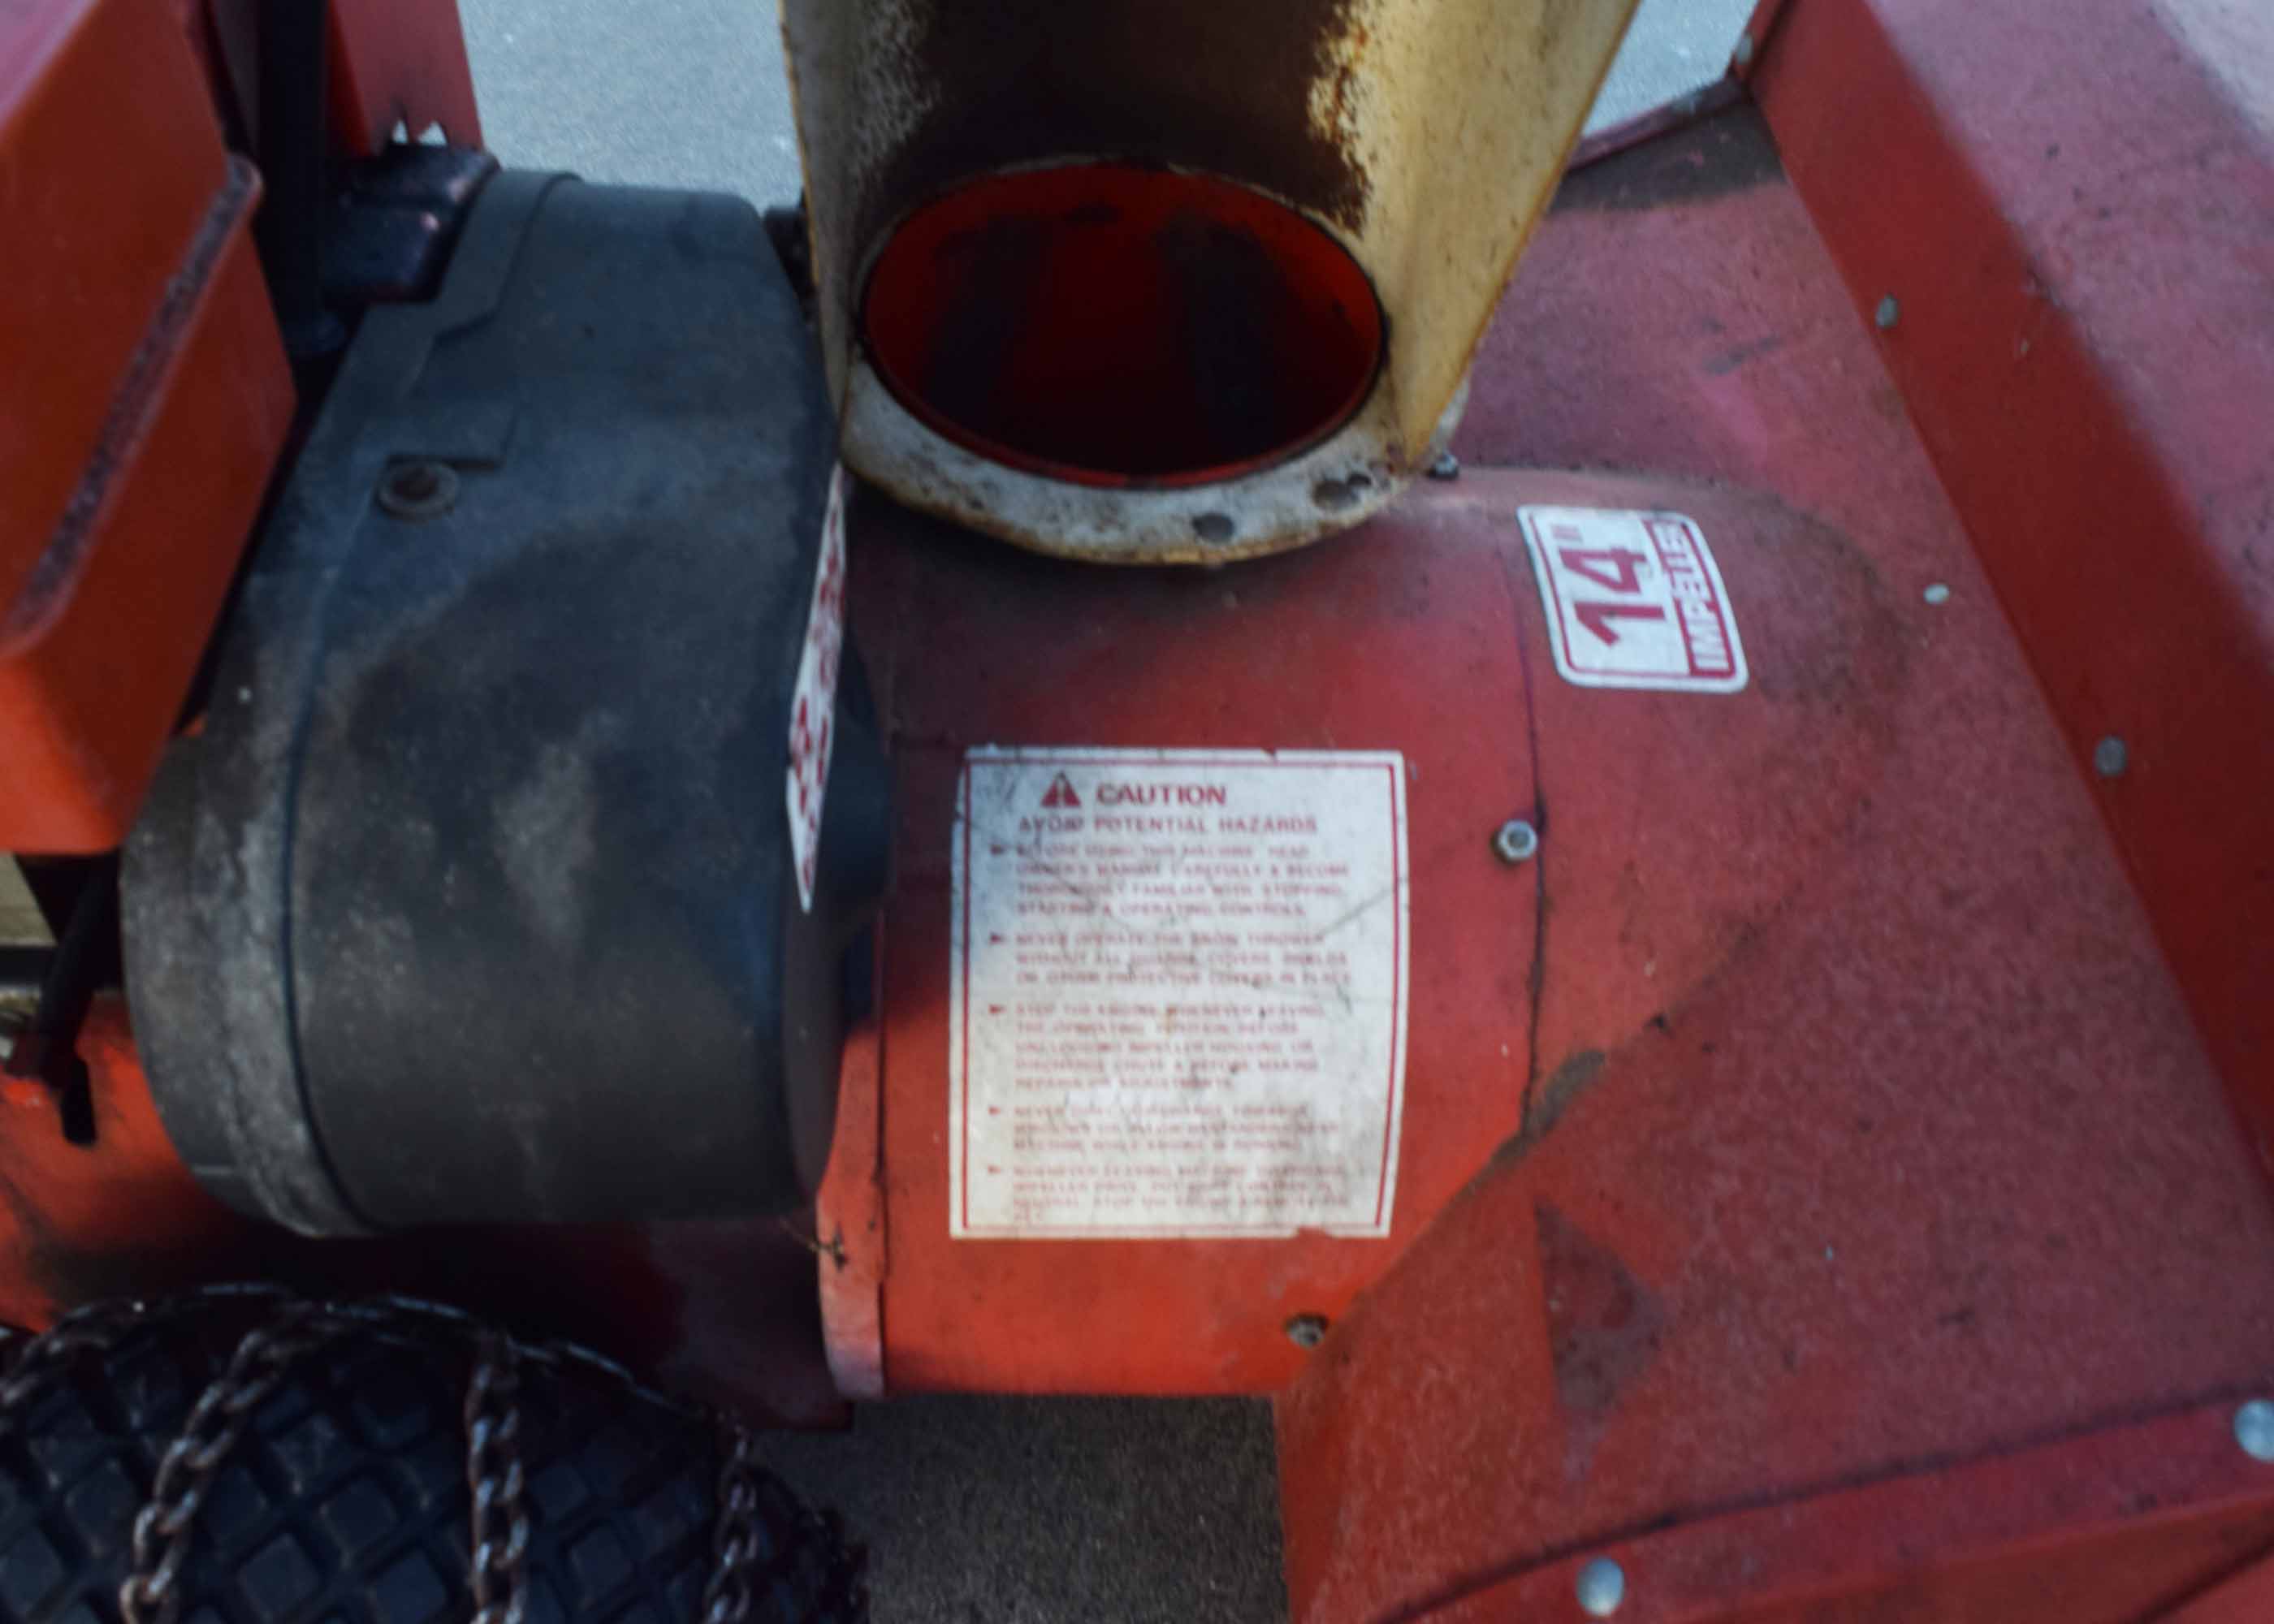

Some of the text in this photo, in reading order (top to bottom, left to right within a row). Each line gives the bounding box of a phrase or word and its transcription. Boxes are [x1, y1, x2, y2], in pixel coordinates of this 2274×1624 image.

[1096, 784, 1228, 806] CAUTION
[1018, 816, 1317, 833] AVOID POTENTIAL HAZARDS
